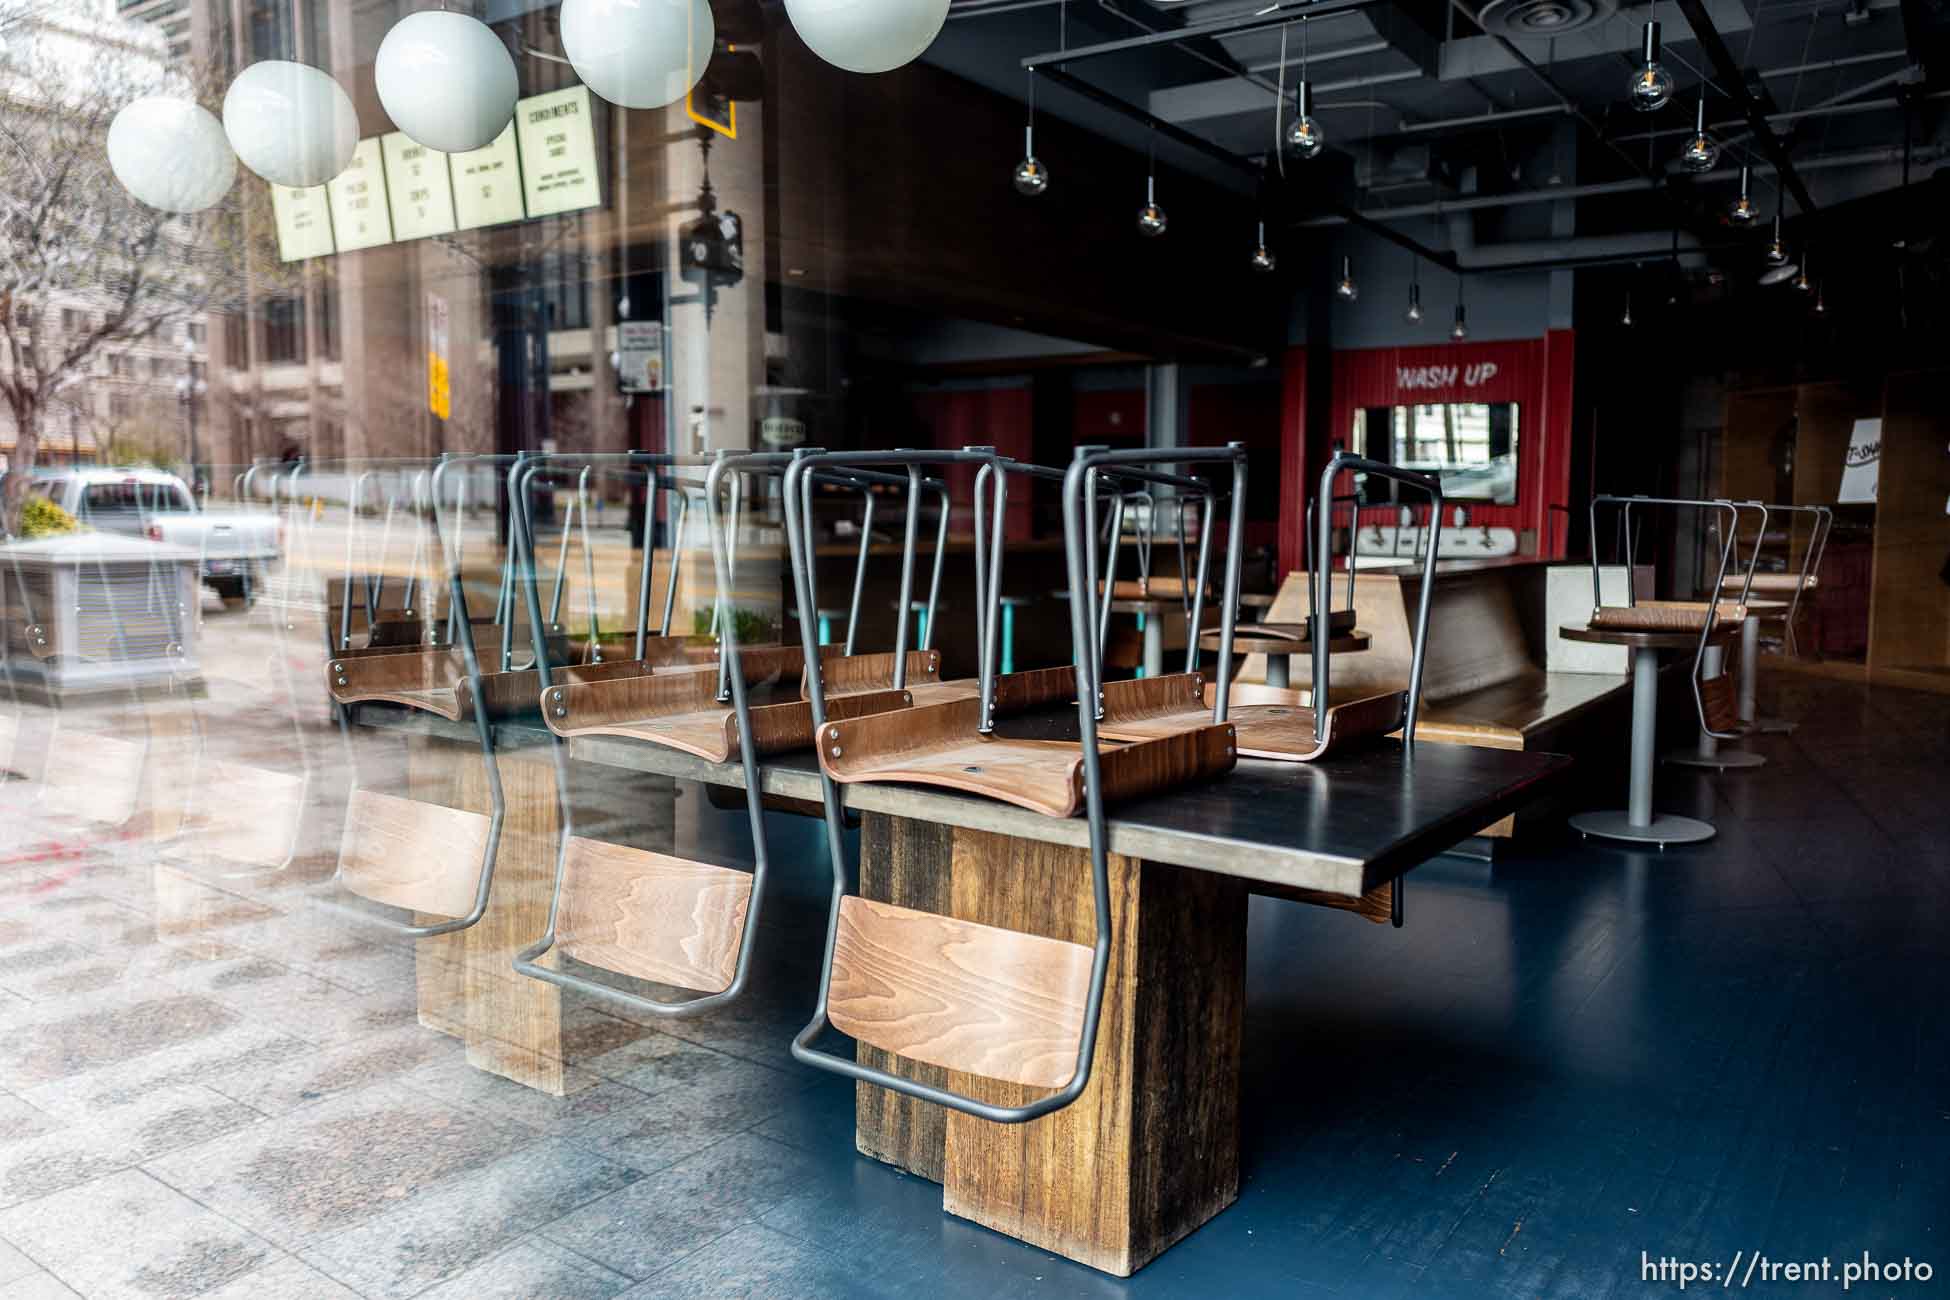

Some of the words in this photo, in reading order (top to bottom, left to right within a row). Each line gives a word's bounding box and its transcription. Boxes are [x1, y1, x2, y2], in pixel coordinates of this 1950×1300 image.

[529, 101, 578, 124] CONDIMENTS
[1396, 366, 1458, 389] WASH
[1464, 362, 1498, 387] UP
